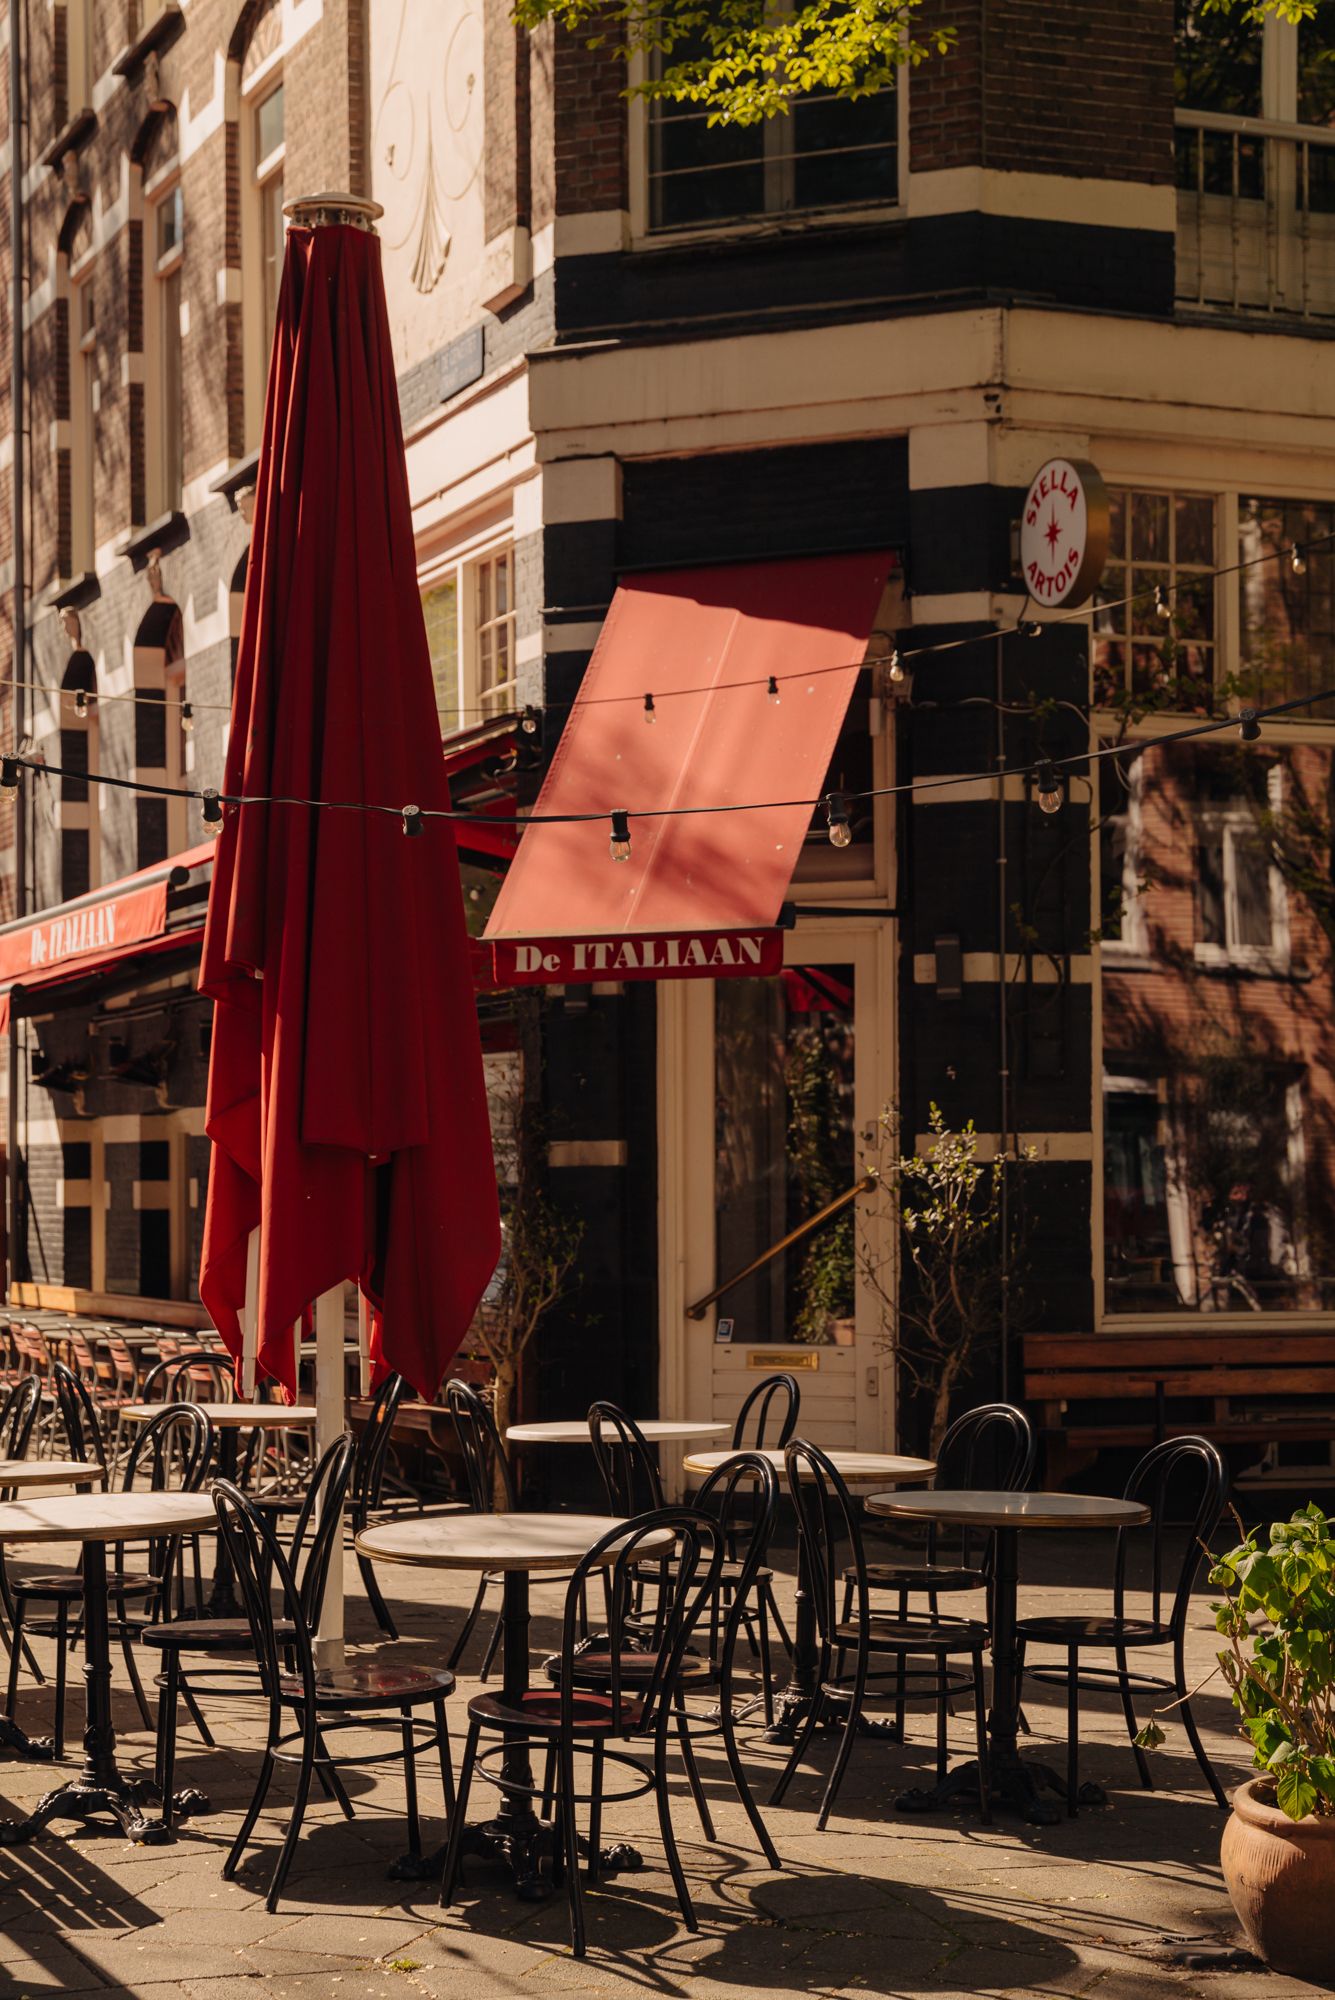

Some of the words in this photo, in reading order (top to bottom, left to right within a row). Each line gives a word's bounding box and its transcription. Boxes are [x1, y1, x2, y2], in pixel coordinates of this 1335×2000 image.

[1026, 469, 1079, 526] STELLA
[1027, 548, 1079, 597] ARTOIS
[30, 928, 47, 965] De
[49, 904, 116, 960] ITALIAAN
[514, 945, 560, 973] De
[573, 937, 765, 970] ITALIAAN
